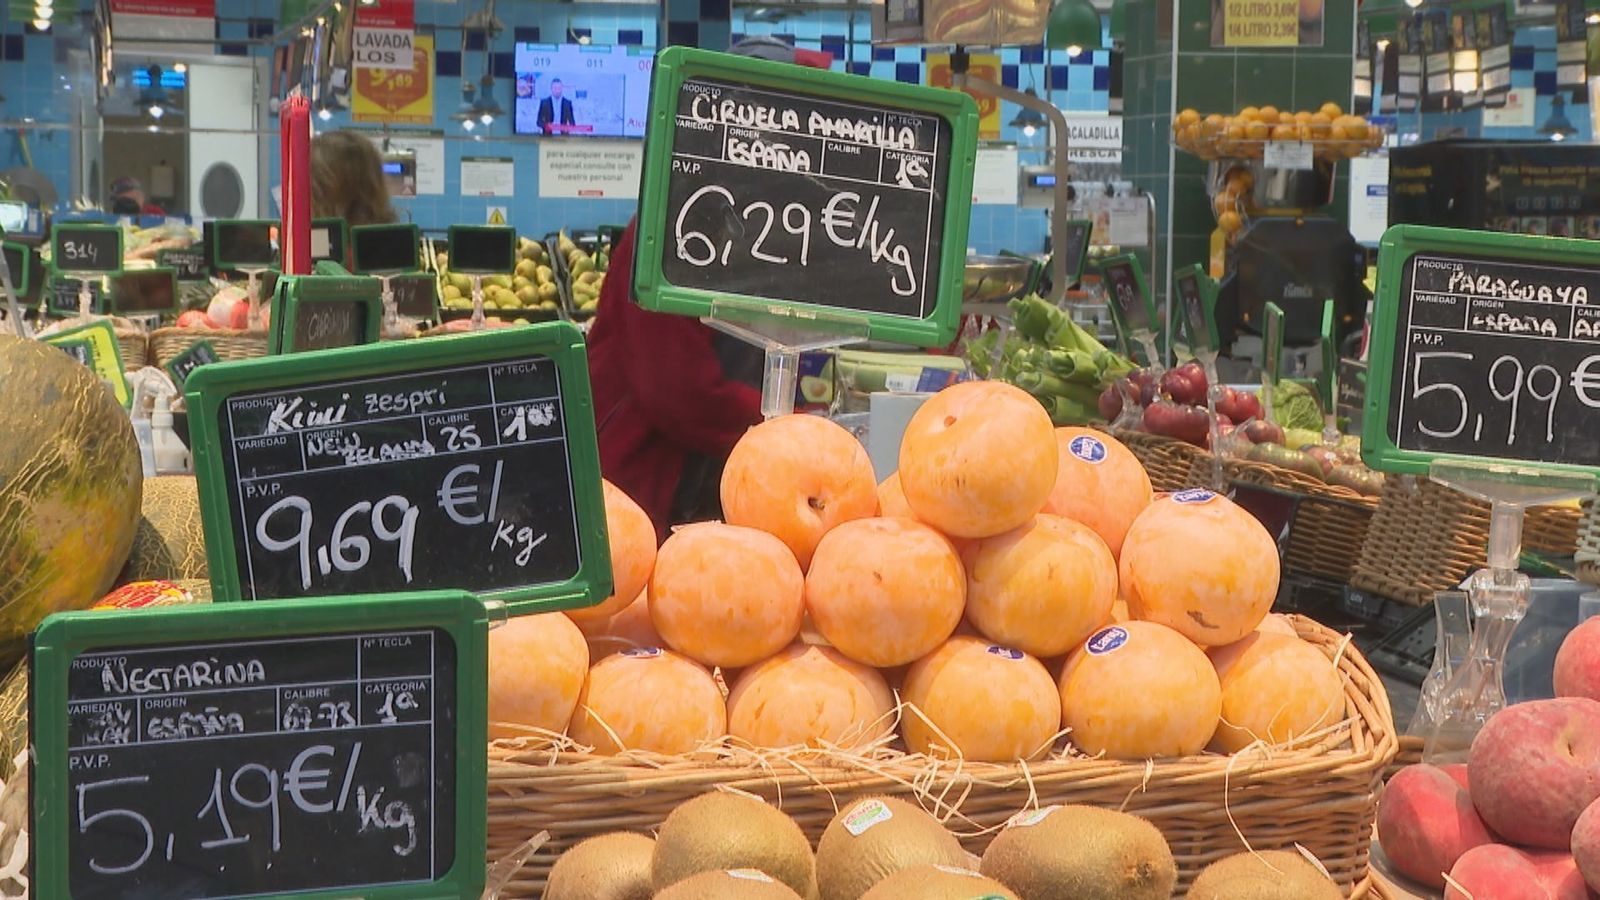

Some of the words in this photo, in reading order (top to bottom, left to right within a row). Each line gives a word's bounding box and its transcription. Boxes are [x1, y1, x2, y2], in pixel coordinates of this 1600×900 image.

[1244, 3, 1271, 17] LITRO
[1244, 23, 1271, 37] LITRO
[356, 32, 411, 50] LAVADA
[534, 57, 551, 67] 019
[587, 59, 603, 68] 011
[638, 60, 652, 71] 00
[682, 84, 721, 97] RODUCTO
[675, 119, 714, 132] VARIEDAD
[729, 128, 760, 139] ORIGEN
[728, 137, 810, 172] ESPAÑA
[828, 143, 861, 155] CALIBRE
[886, 151, 930, 165] CATEGORIA
[672, 160, 702, 175] P.V.P.
[63, 241, 98, 263] 314
[1448, 271, 1588, 305] PARAGUAYA
[1415, 294, 1457, 305] VARIEDAD
[1472, 300, 1504, 309] ORIGEN
[1413, 333, 1444, 346] P.V.P.
[507, 363, 538, 375] TECLA
[428, 413, 470, 426] CALIBRE
[306, 429, 344, 442] ORIGEN
[440, 424, 482, 451] 25
[238, 436, 287, 450] VARIEDAD
[246, 482, 284, 499] P.V.P.
[255, 495, 419, 592] 9,69
[379, 637, 412, 648] TECLA
[73, 656, 127, 669] RODUCTO
[284, 688, 331, 700] CALIBRE
[365, 681, 426, 695] CATEGORIA
[145, 698, 187, 710] ORIGEN
[69, 754, 111, 770] P.V.P.
